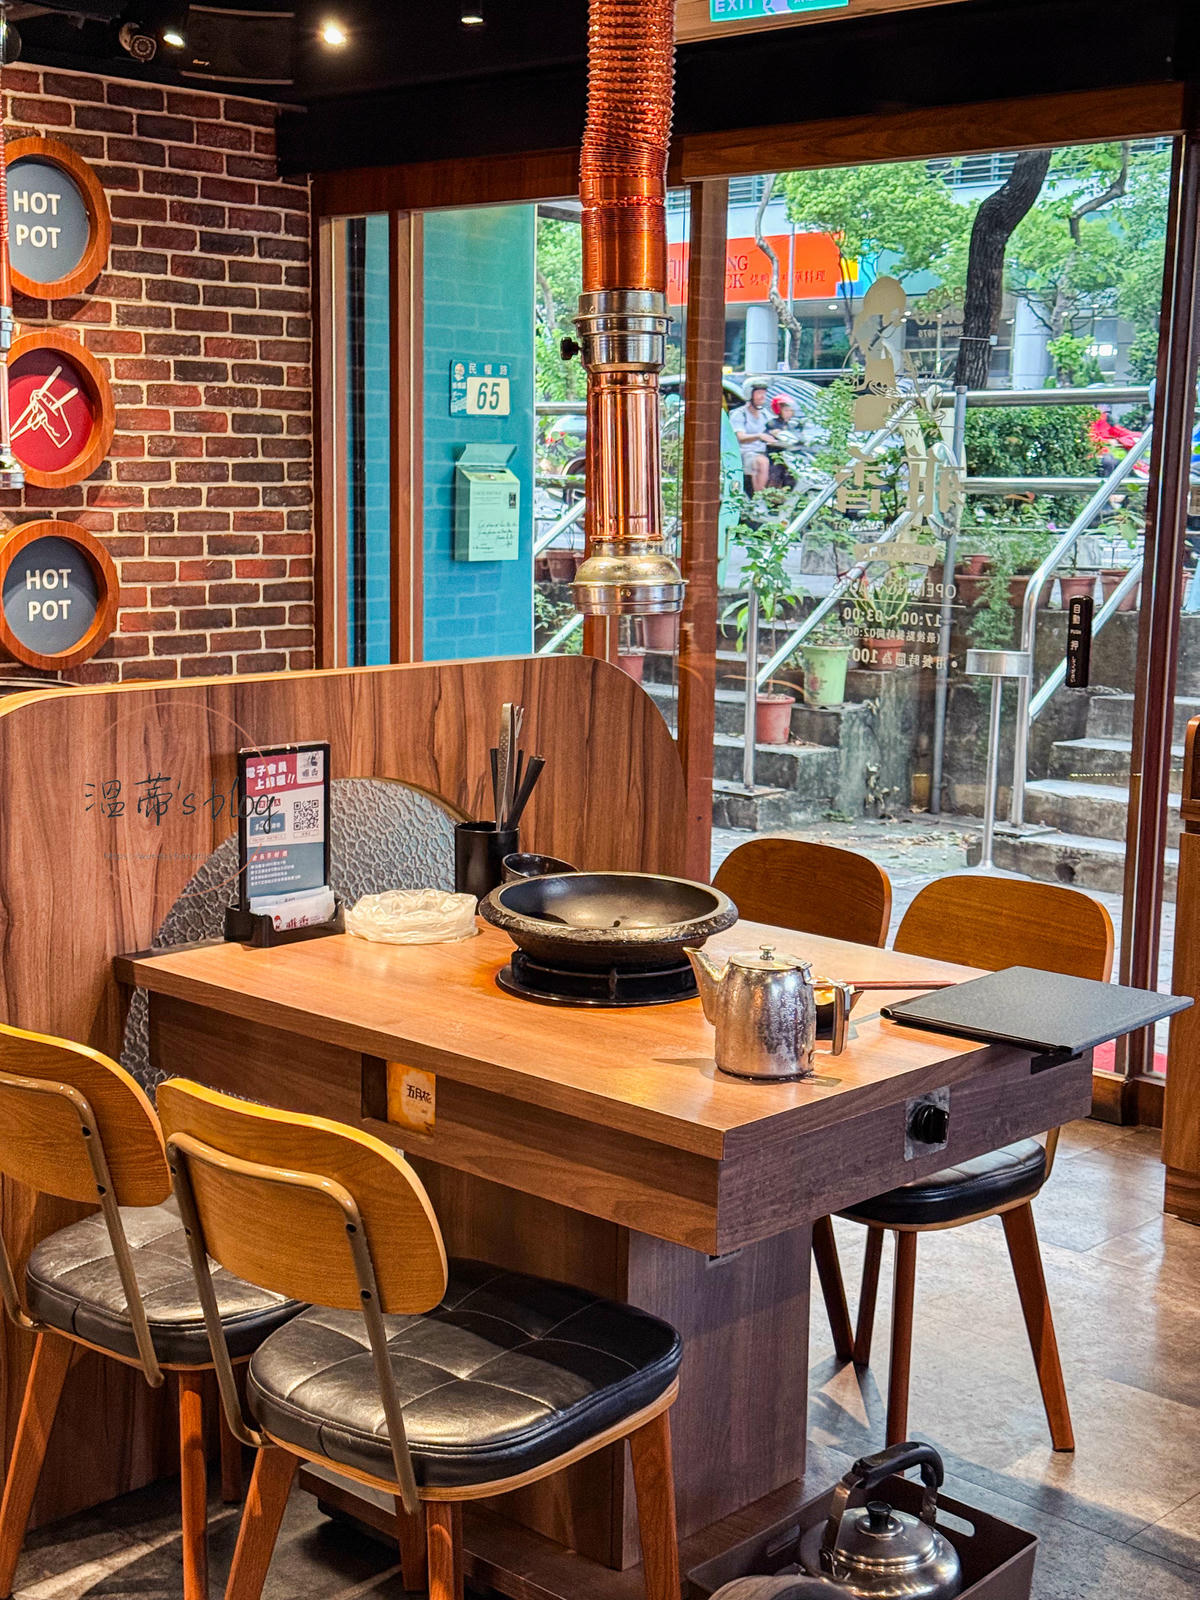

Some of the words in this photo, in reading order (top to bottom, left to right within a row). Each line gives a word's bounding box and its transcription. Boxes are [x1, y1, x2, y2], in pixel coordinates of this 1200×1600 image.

[13, 189, 61, 216] HOT
[15, 223, 61, 249] POT
[477, 382, 501, 410] 65
[25, 568, 72, 590] HOT
[27, 599, 72, 622] POT
